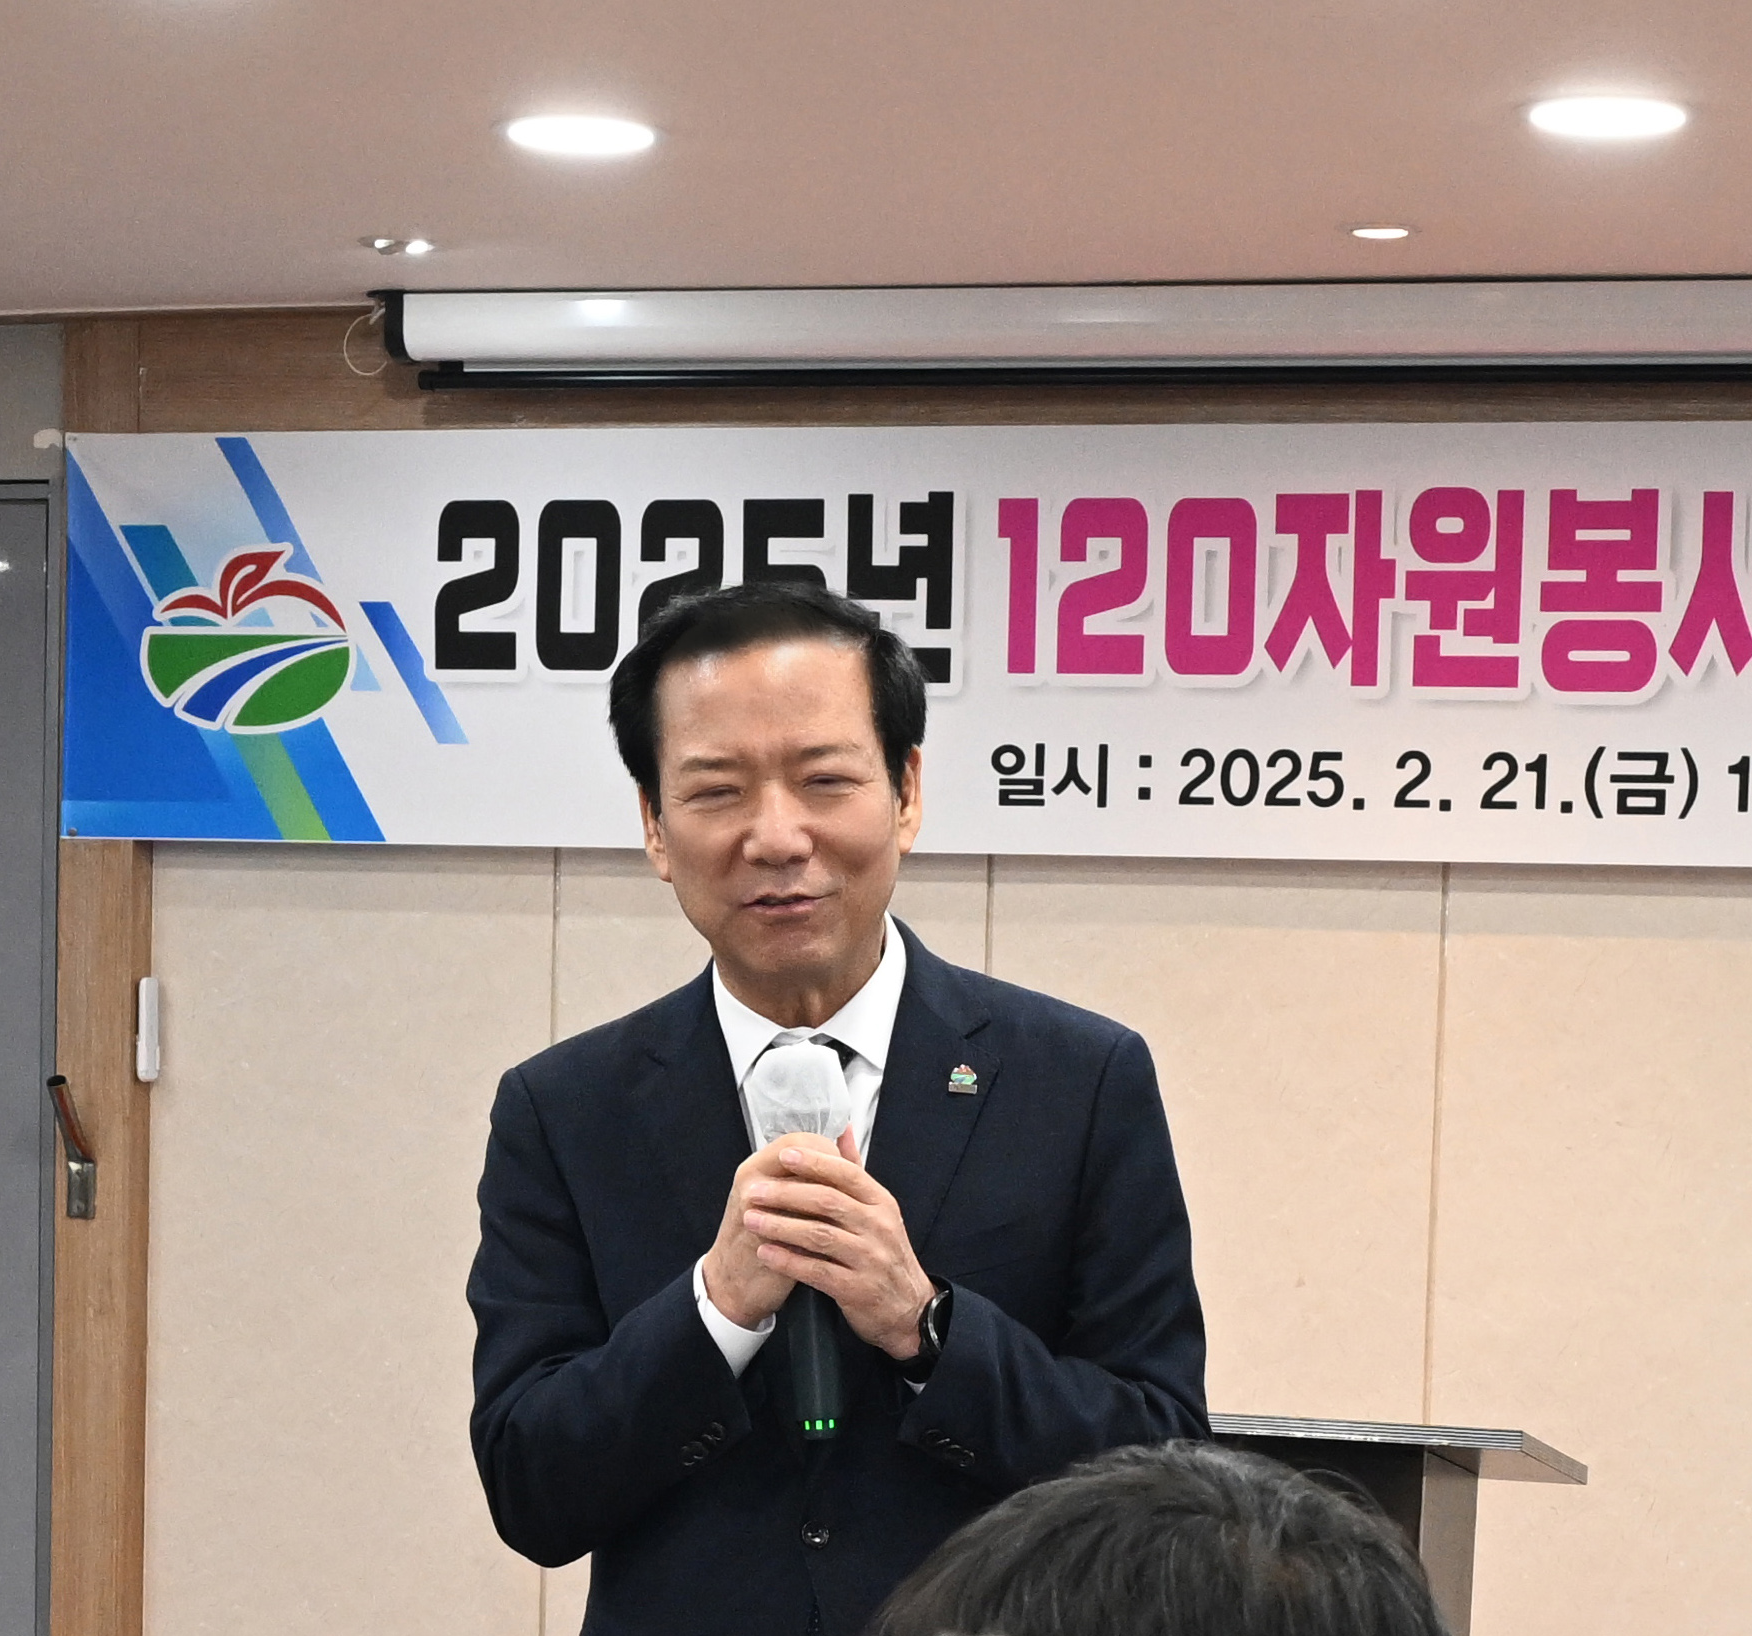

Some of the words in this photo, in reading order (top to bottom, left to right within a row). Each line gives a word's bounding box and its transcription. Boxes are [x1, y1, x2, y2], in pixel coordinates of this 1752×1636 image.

[991, 743, 1109, 808] 일시
[1179, 748, 1365, 810] 2025.
[1395, 750, 1452, 812] 2.
